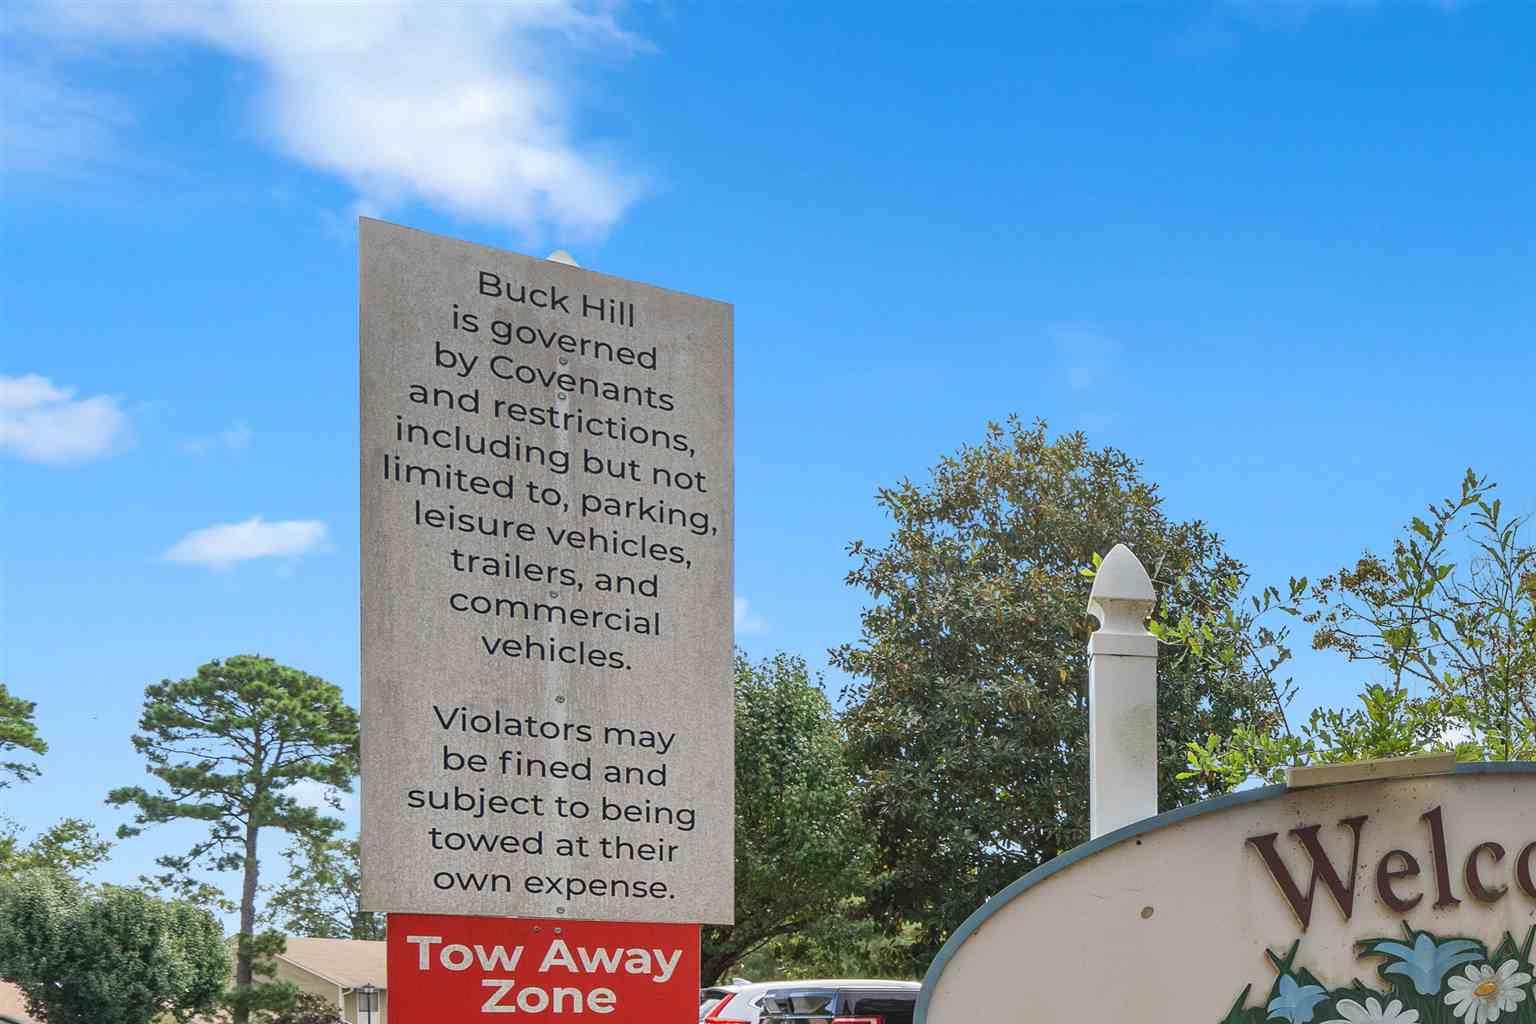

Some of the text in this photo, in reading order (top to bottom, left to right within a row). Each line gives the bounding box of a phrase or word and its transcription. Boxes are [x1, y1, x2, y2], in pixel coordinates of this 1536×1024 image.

[479, 271, 635, 327] Buck Hill
[453, 304, 657, 370] is governed
[435, 342, 675, 411] by Covenants
[409, 384, 696, 457] and restrictions,
[396, 416, 706, 493] including but not
[384, 454, 718, 536] limited to, parking,
[415, 501, 692, 569] leisure vehicles,
[451, 547, 659, 597] trailers, and
[450, 591, 660, 635] commercial
[481, 635, 632, 670] vehicles.
[433, 705, 675, 754] Violators may
[443, 746, 667, 786] be fined and
[407, 787, 696, 831] subject to being
[429, 827, 679, 862] towed at their
[433, 870, 675, 900] own expense.
[407, 935, 683, 983] Tow Away
[480, 979, 617, 1014] Zone
